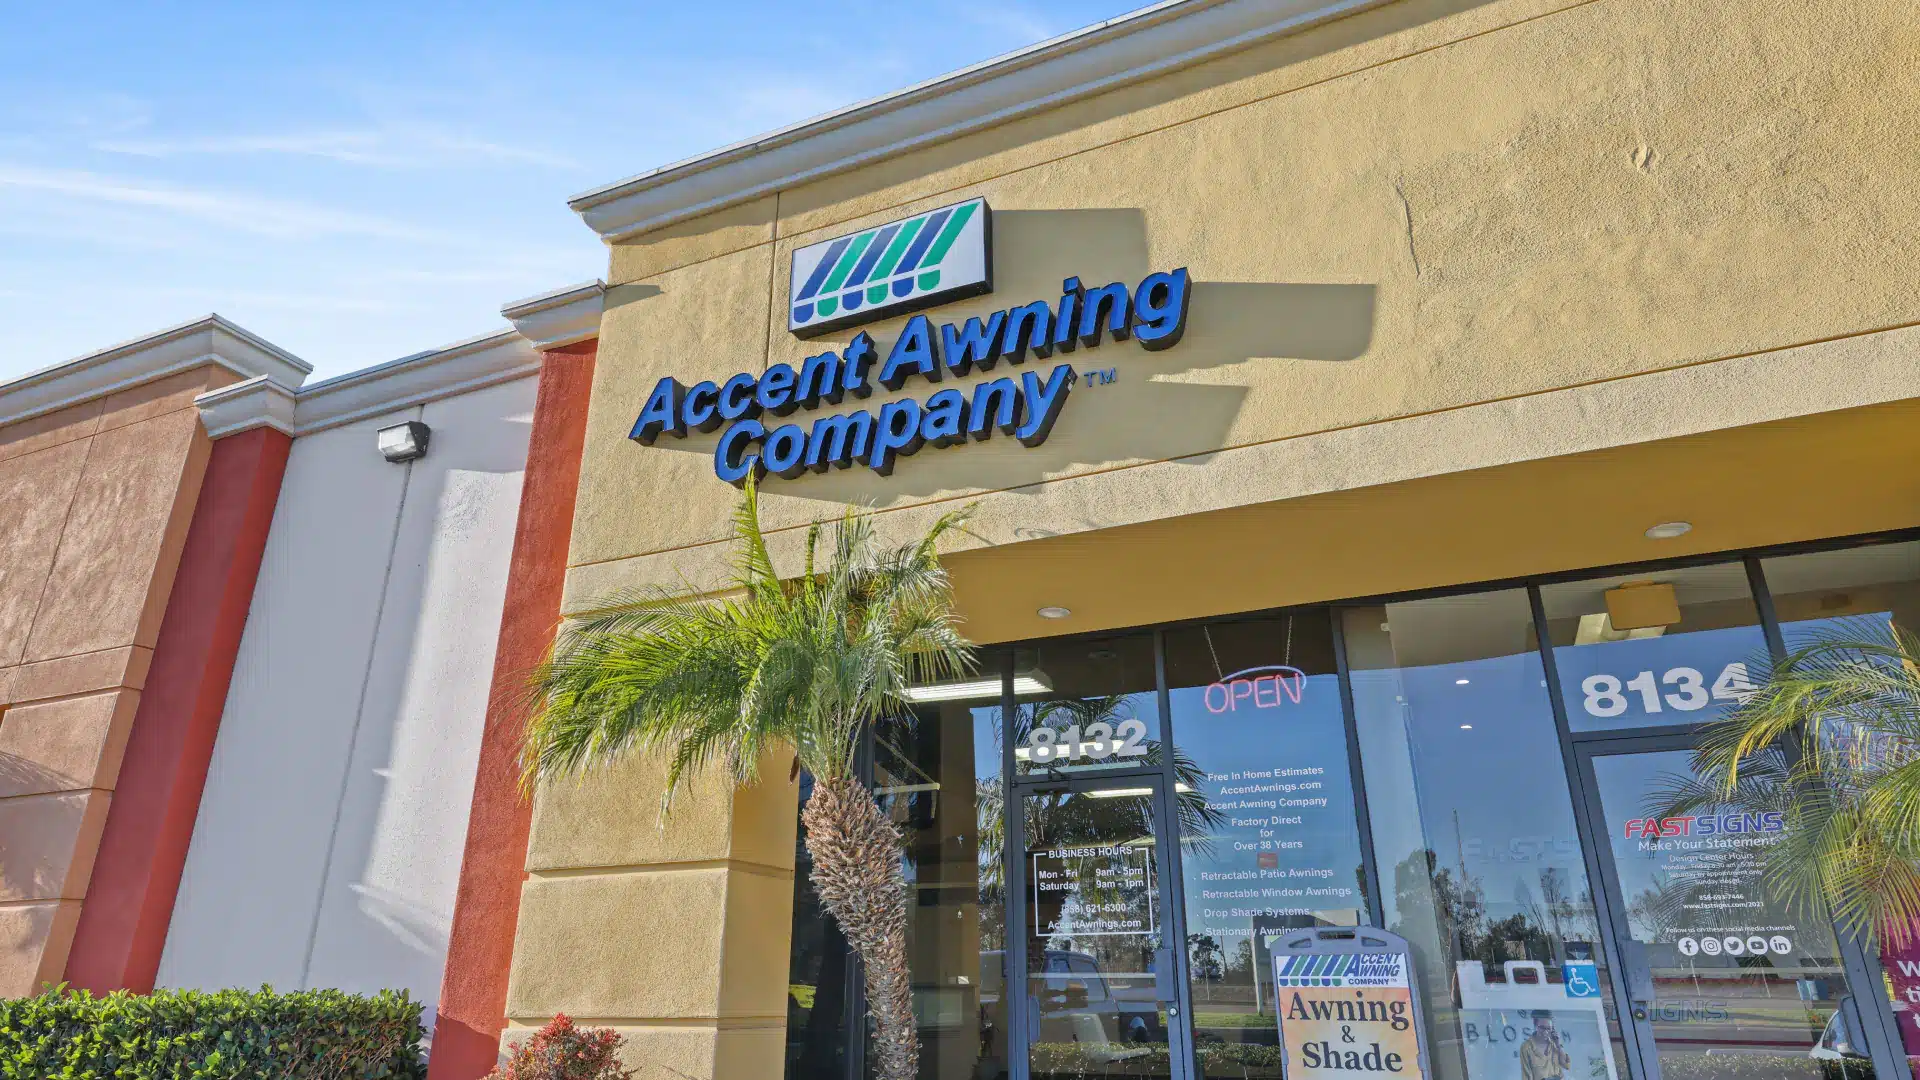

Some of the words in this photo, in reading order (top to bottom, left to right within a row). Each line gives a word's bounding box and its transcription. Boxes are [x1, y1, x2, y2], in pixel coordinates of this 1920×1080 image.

[629, 330, 878, 446] Accent
[878, 267, 1191, 391] Awning
[715, 364, 1077, 488] Company
[1083, 367, 1116, 388] TM
[1205, 673, 1301, 713] OPEN
[1581, 662, 1759, 718] 8134
[1028, 719, 1147, 763] 8132
[1208, 773, 1228, 782] Free
[1231, 772, 1240, 780] In
[1243, 770, 1271, 779] Home
[1274, 766, 1324, 777] Estimates
[1220, 782, 1322, 795] AccentAwnings.com
[1204, 801, 1237, 811] Accent
[1239, 799, 1276, 809] Awning
[1279, 797, 1328, 808] Company
[1231, 817, 1268, 827] Factory
[1271, 815, 1302, 825] Direct
[1624, 811, 1785, 839] FASTSIGNS
[1260, 828, 1274, 837] for
[1234, 841, 1258, 851] Over
[1260, 841, 1271, 850] 38
[1274, 840, 1303, 850] Years
[1638, 840, 1672, 852] Make
[1674, 838, 1702, 850] Your
[1705, 836, 1776, 849] Statement
[1048, 848, 1095, 859] BUSINESS
[1098, 846, 1132, 857] HOURS
[1669, 854, 1698, 864] Design
[1699, 853, 1727, 862] Center
[1728, 852, 1754, 861] Hours
[1039, 870, 1058, 879] Mon
[1065, 869, 1078, 878] Fri
[1095, 868, 1115, 877] 9am
[1123, 867, 1143, 876] 5pm
[1661, 863, 1686, 871] Monday
[1201, 869, 1257, 881] Retractable
[1260, 868, 1286, 879] Patio
[1288, 867, 1334, 879] Awnings
[1040, 881, 1080, 892] Saturday
[1096, 879, 1116, 889] 9am
[1124, 879, 1144, 889] 1pm
[1202, 888, 1259, 899] Retractable
[1261, 886, 1303, 897] Window
[1305, 886, 1351, 896] Awnings
[1061, 904, 1083, 914] (858)
[1086, 903, 1126, 913] 621-6300
[1204, 907, 1228, 918] Drop
[1231, 906, 1263, 917] Shade
[1266, 906, 1310, 918] Systems
[1048, 919, 1142, 931] AccentAwnings.com
[1205, 926, 1256, 938] Stationary
[1259, 925, 1300, 936] Awning
[1766, 924, 1796, 932] channels
[1286, 990, 1409, 1031] Awning
[1341, 1024, 1356, 1043] &
[1302, 1041, 1403, 1073] Shade
